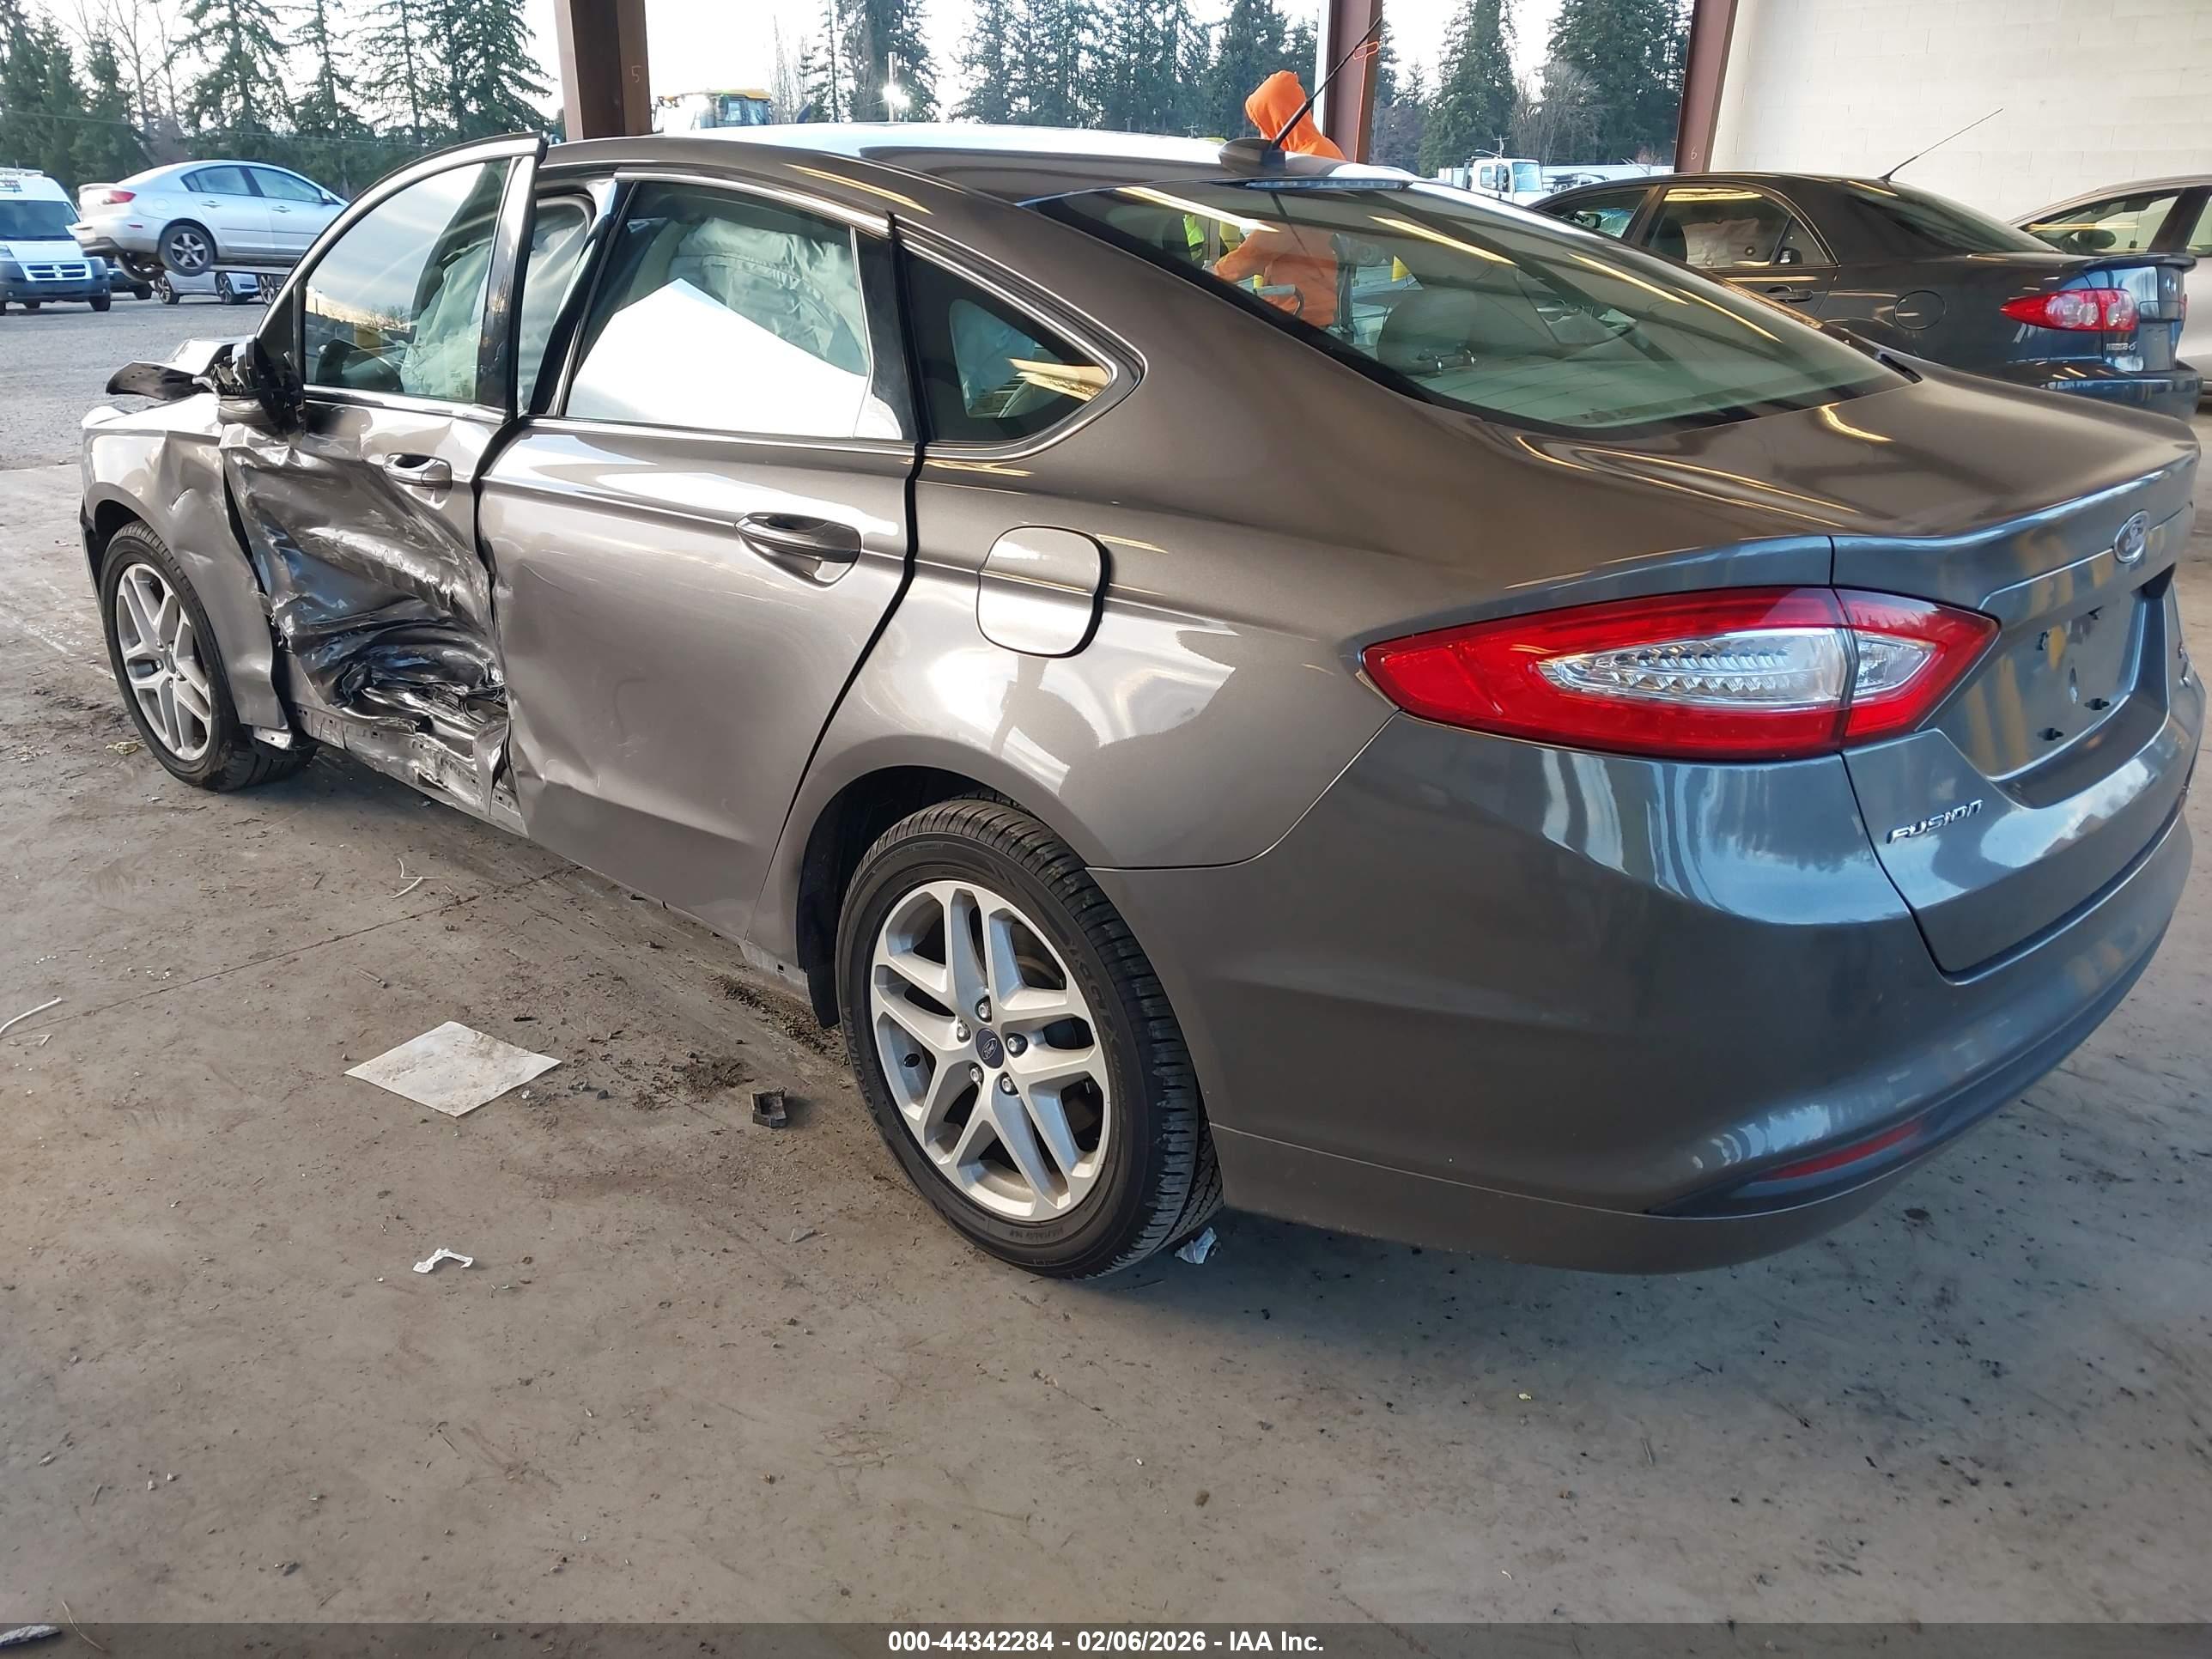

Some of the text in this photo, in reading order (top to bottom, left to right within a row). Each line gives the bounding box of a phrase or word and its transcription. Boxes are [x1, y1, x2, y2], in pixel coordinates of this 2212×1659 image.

[631, 64, 642, 83] 5
[1691, 145, 1698, 161] 6
[1887, 799, 1984, 844] FUSION
